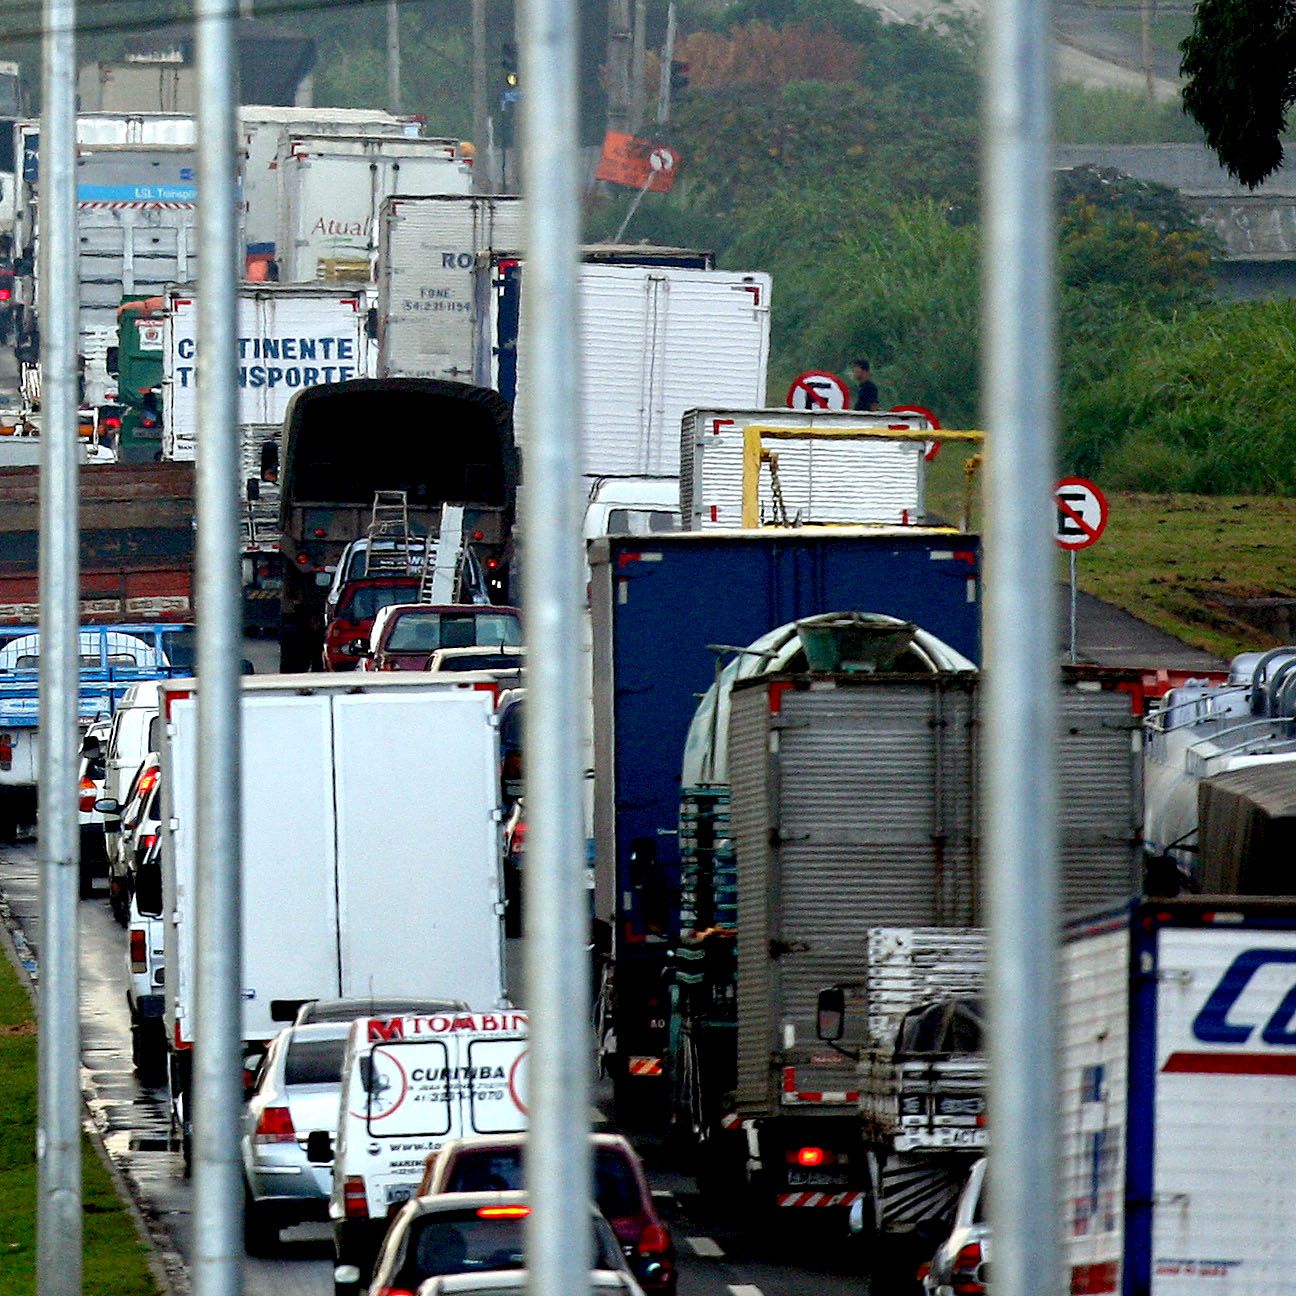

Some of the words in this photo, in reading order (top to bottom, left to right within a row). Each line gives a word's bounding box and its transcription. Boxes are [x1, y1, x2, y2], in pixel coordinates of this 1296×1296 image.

[441, 252, 475, 269] RO
[178, 337, 354, 361] CTINENTE
[411, 1066, 506, 1082] CURITIBA
[390, 1141, 443, 1152] www.to
